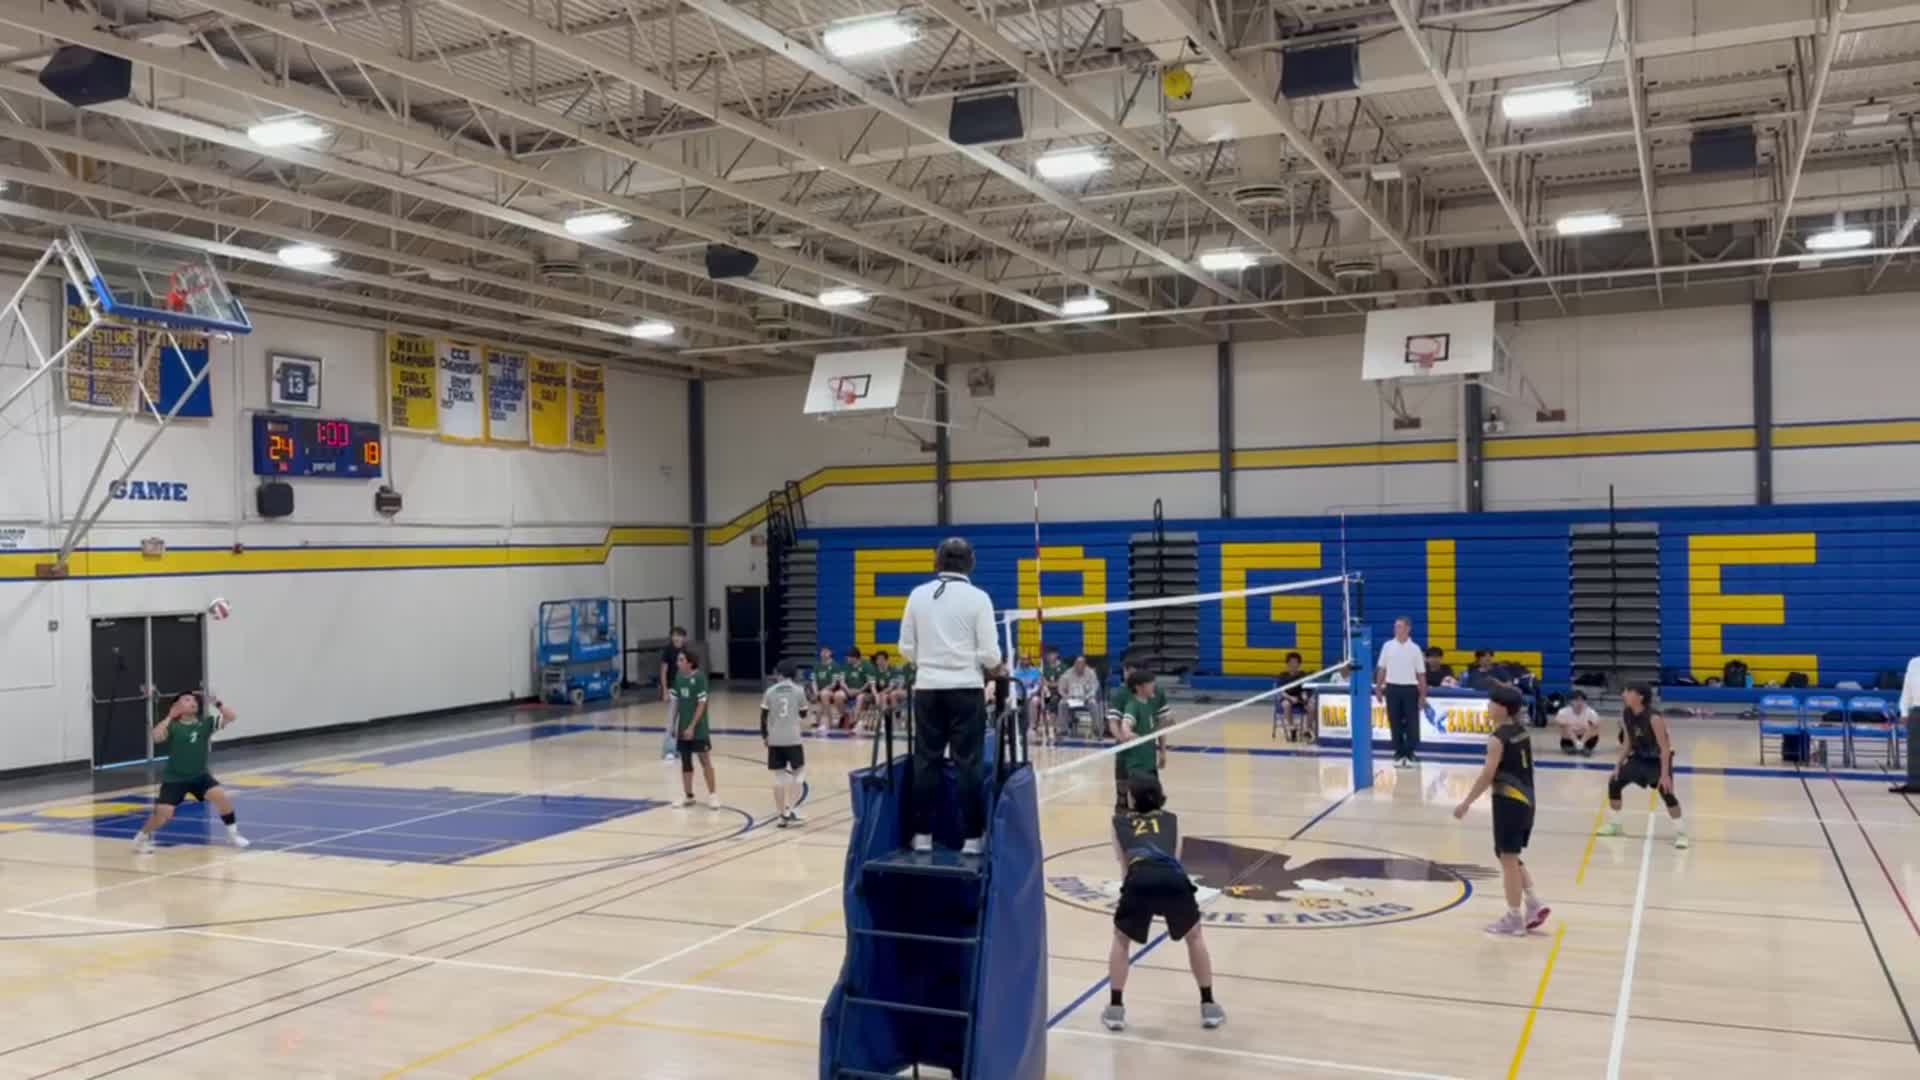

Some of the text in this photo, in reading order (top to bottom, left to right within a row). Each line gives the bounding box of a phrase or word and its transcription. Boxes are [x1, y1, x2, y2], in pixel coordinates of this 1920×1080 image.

[288, 376, 305, 395] 13
[316, 420, 351, 448] 1:00
[269, 434, 294, 461] 24
[109, 480, 189, 502] GAME
[778, 698, 790, 718] 3
[1321, 704, 1348, 728] OAK
[1131, 818, 1161, 837] 21
[1265, 902, 1414, 924] EAGLES
